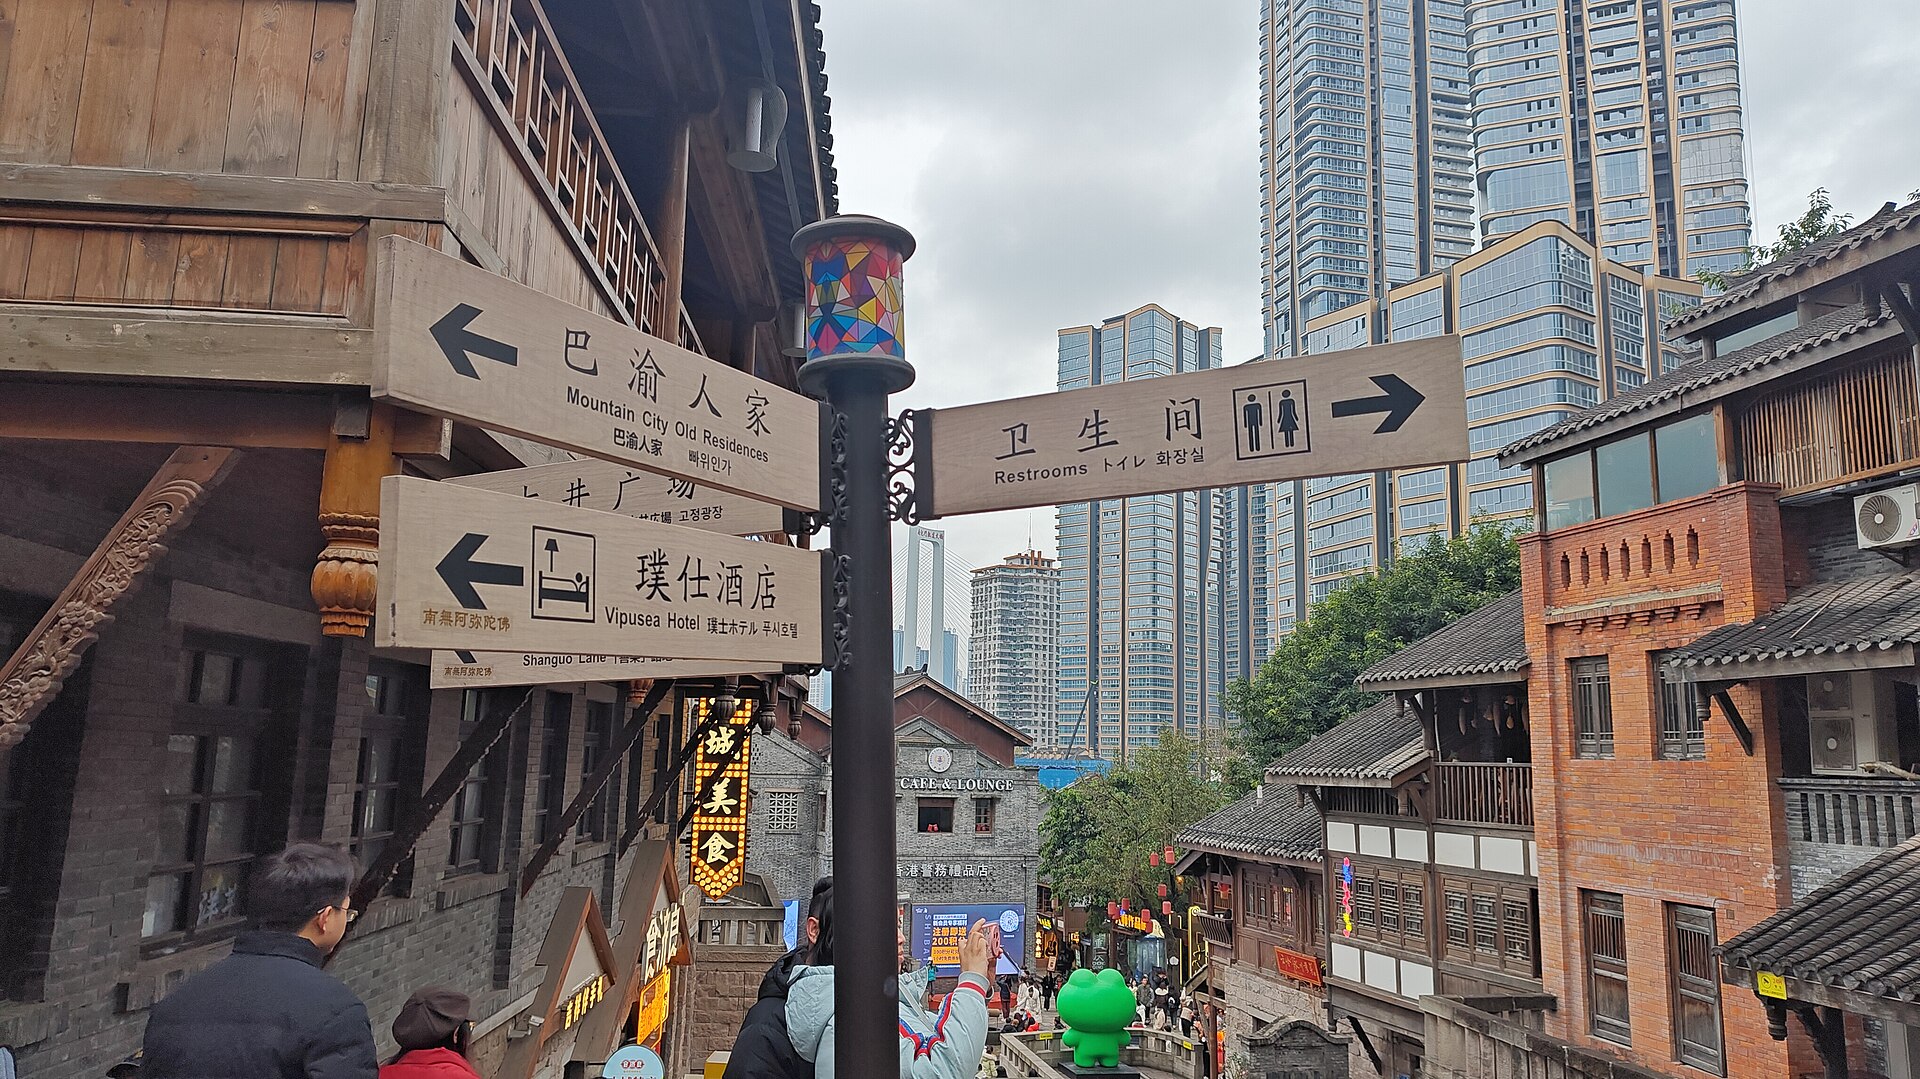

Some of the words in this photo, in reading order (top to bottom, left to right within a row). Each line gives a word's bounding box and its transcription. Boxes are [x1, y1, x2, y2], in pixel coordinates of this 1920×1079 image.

[564, 327, 771, 437] 巴渝人家
[567, 386, 634, 422] Mountain
[643, 410, 668, 435] City
[675, 421, 696, 440] Old
[704, 429, 769, 462] Residences
[995, 398, 1202, 461] 卫生间
[613, 427, 663, 457] 巴渝人家
[688, 449, 732, 476] 빠위인가
[1104, 456, 1146, 472] トイレ
[1156, 446, 1204, 466] 화장실
[995, 464, 1088, 484] Restrooms
[679, 505, 723, 522] 고정광장
[635, 548, 776, 611] 璞仕酒店
[605, 606, 660, 629] Vipusea
[667, 612, 700, 630] Hotel
[762, 620, 798, 639] 푸시호텔
[523, 654, 573, 667] Shanguo
[578, 654, 606, 664] Lane
[703, 698, 741, 868] 城美食
[900, 777, 937, 790] CAFE
[942, 778, 953, 790] &
[957, 778, 1014, 791] LOUNGE
